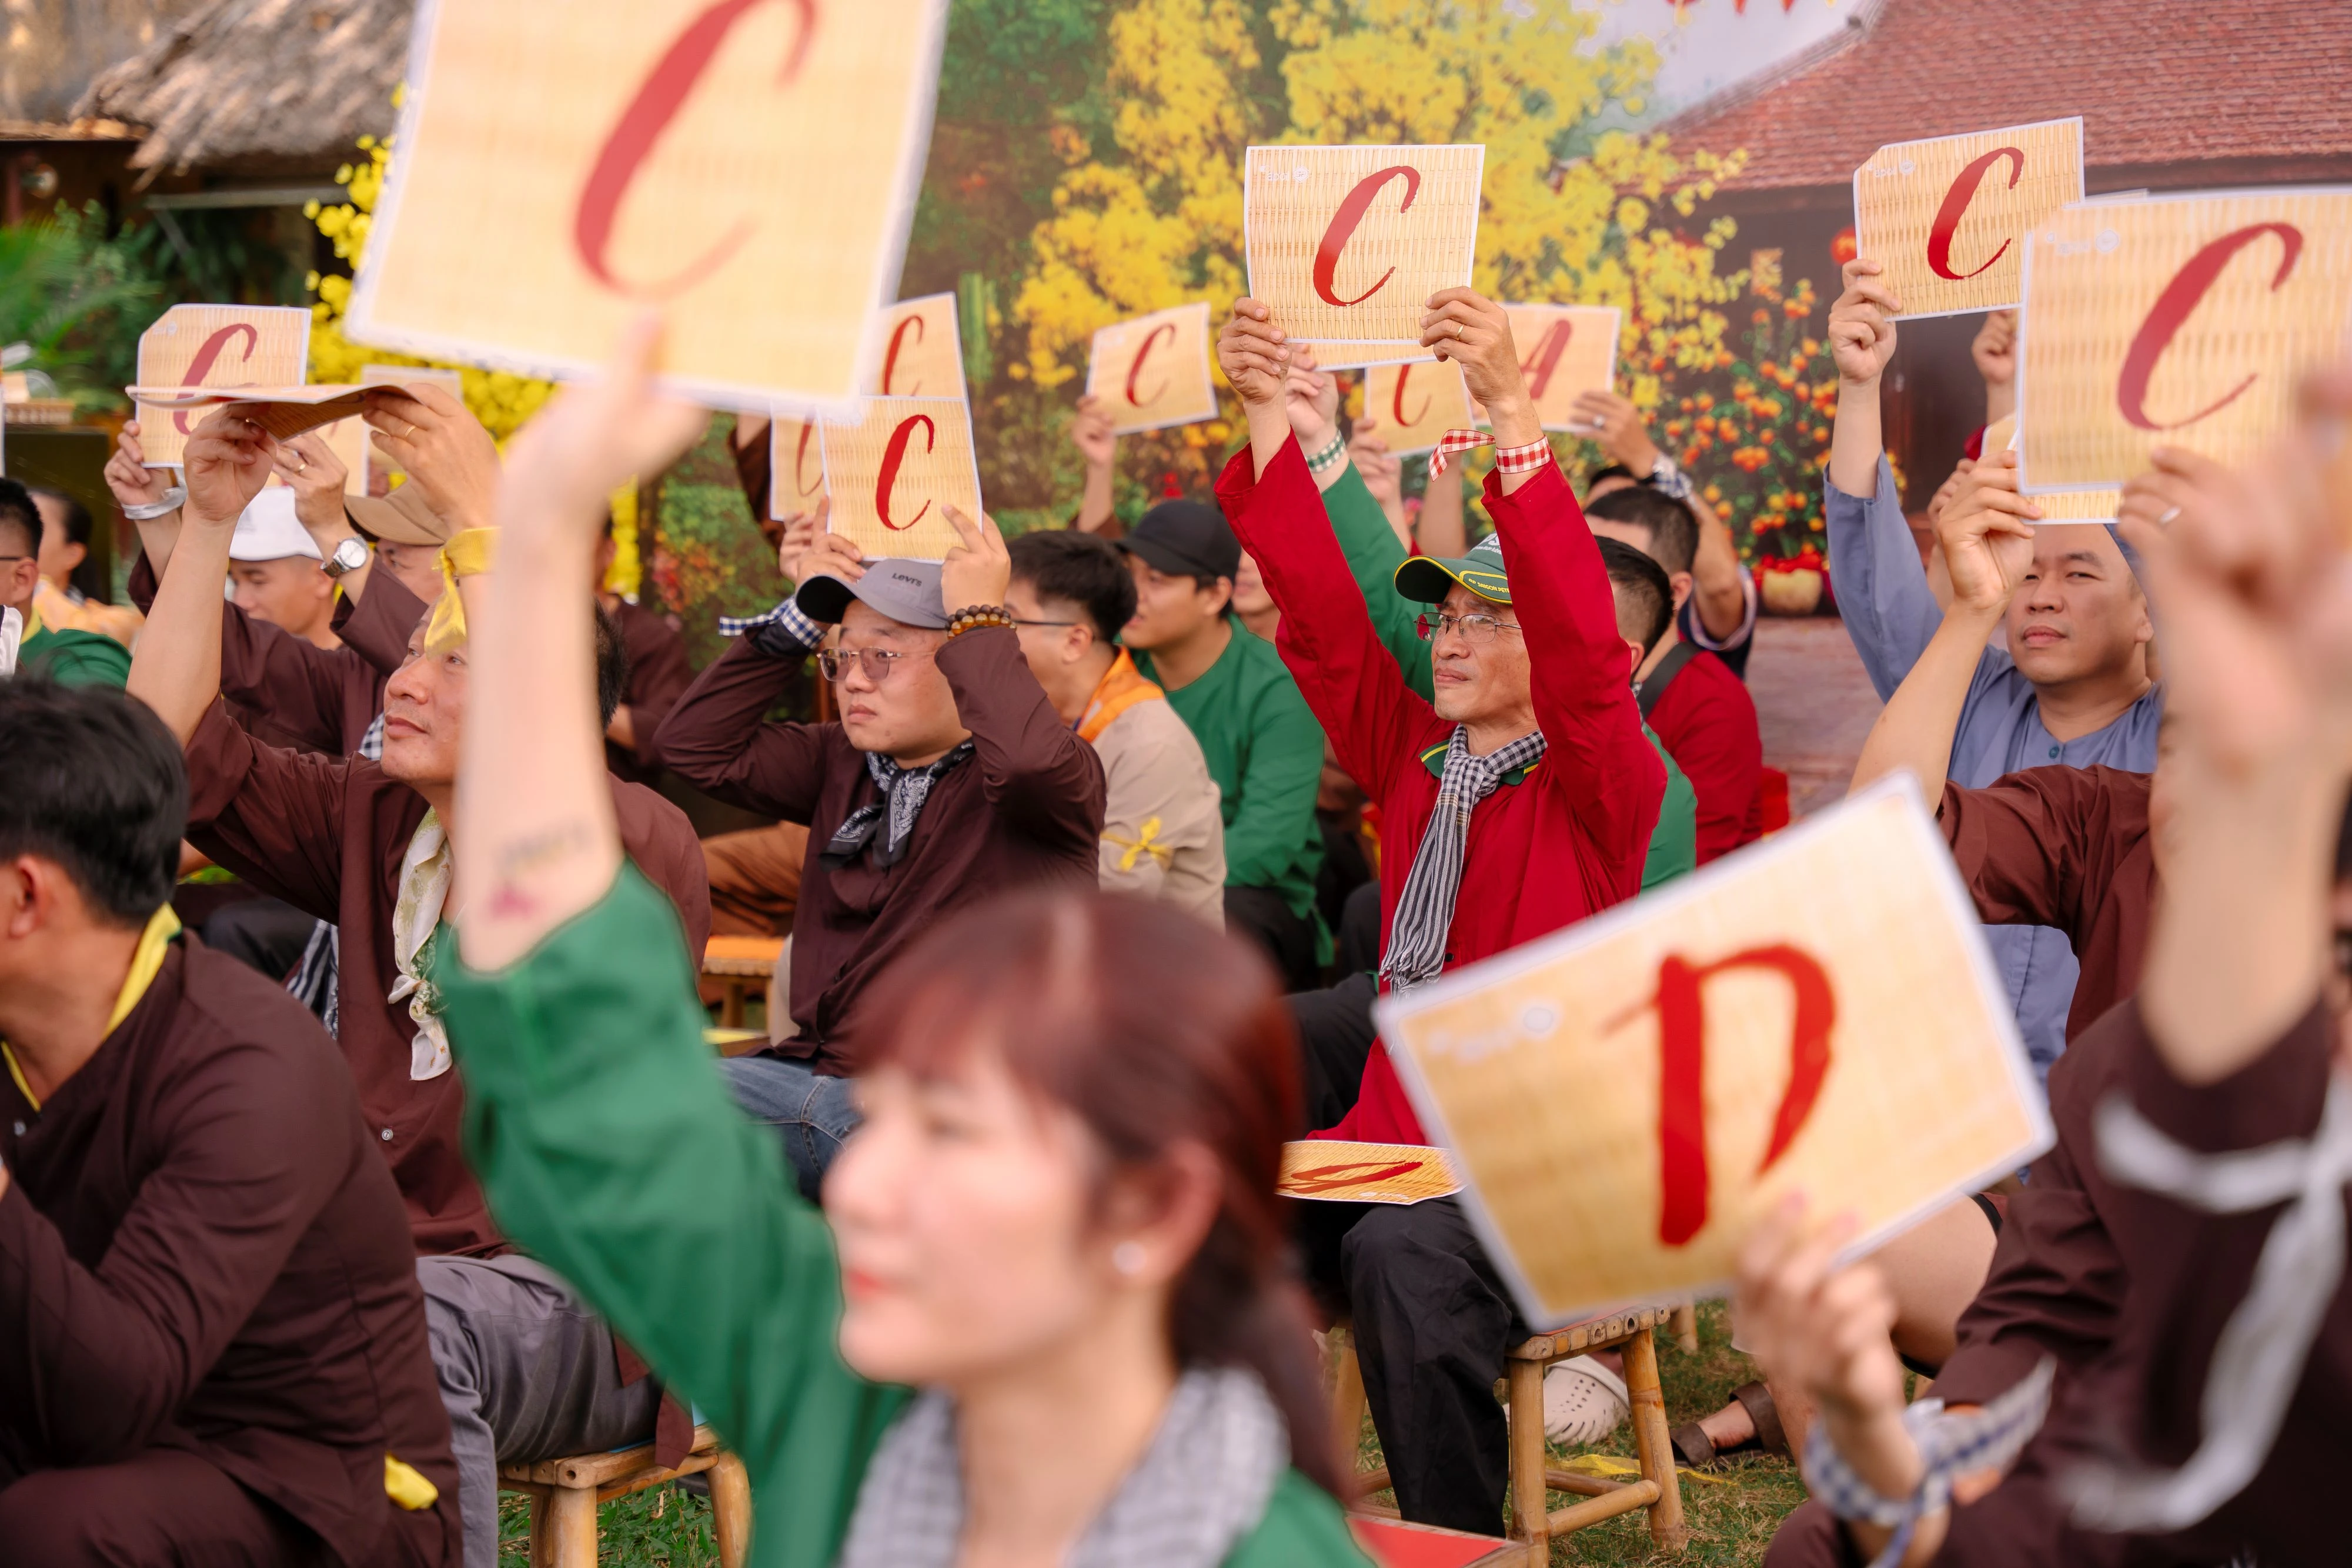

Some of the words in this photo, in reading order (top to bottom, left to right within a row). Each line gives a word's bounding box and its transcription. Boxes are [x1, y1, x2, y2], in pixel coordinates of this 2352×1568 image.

[568, 0, 820, 300] C
[1313, 165, 1421, 307] C
[1927, 146, 2024, 280] C
[172, 323, 258, 436] C
[883, 314, 924, 396] C
[1125, 323, 1175, 408] C
[2116, 221, 2305, 431] C
[875, 414, 935, 531] C
